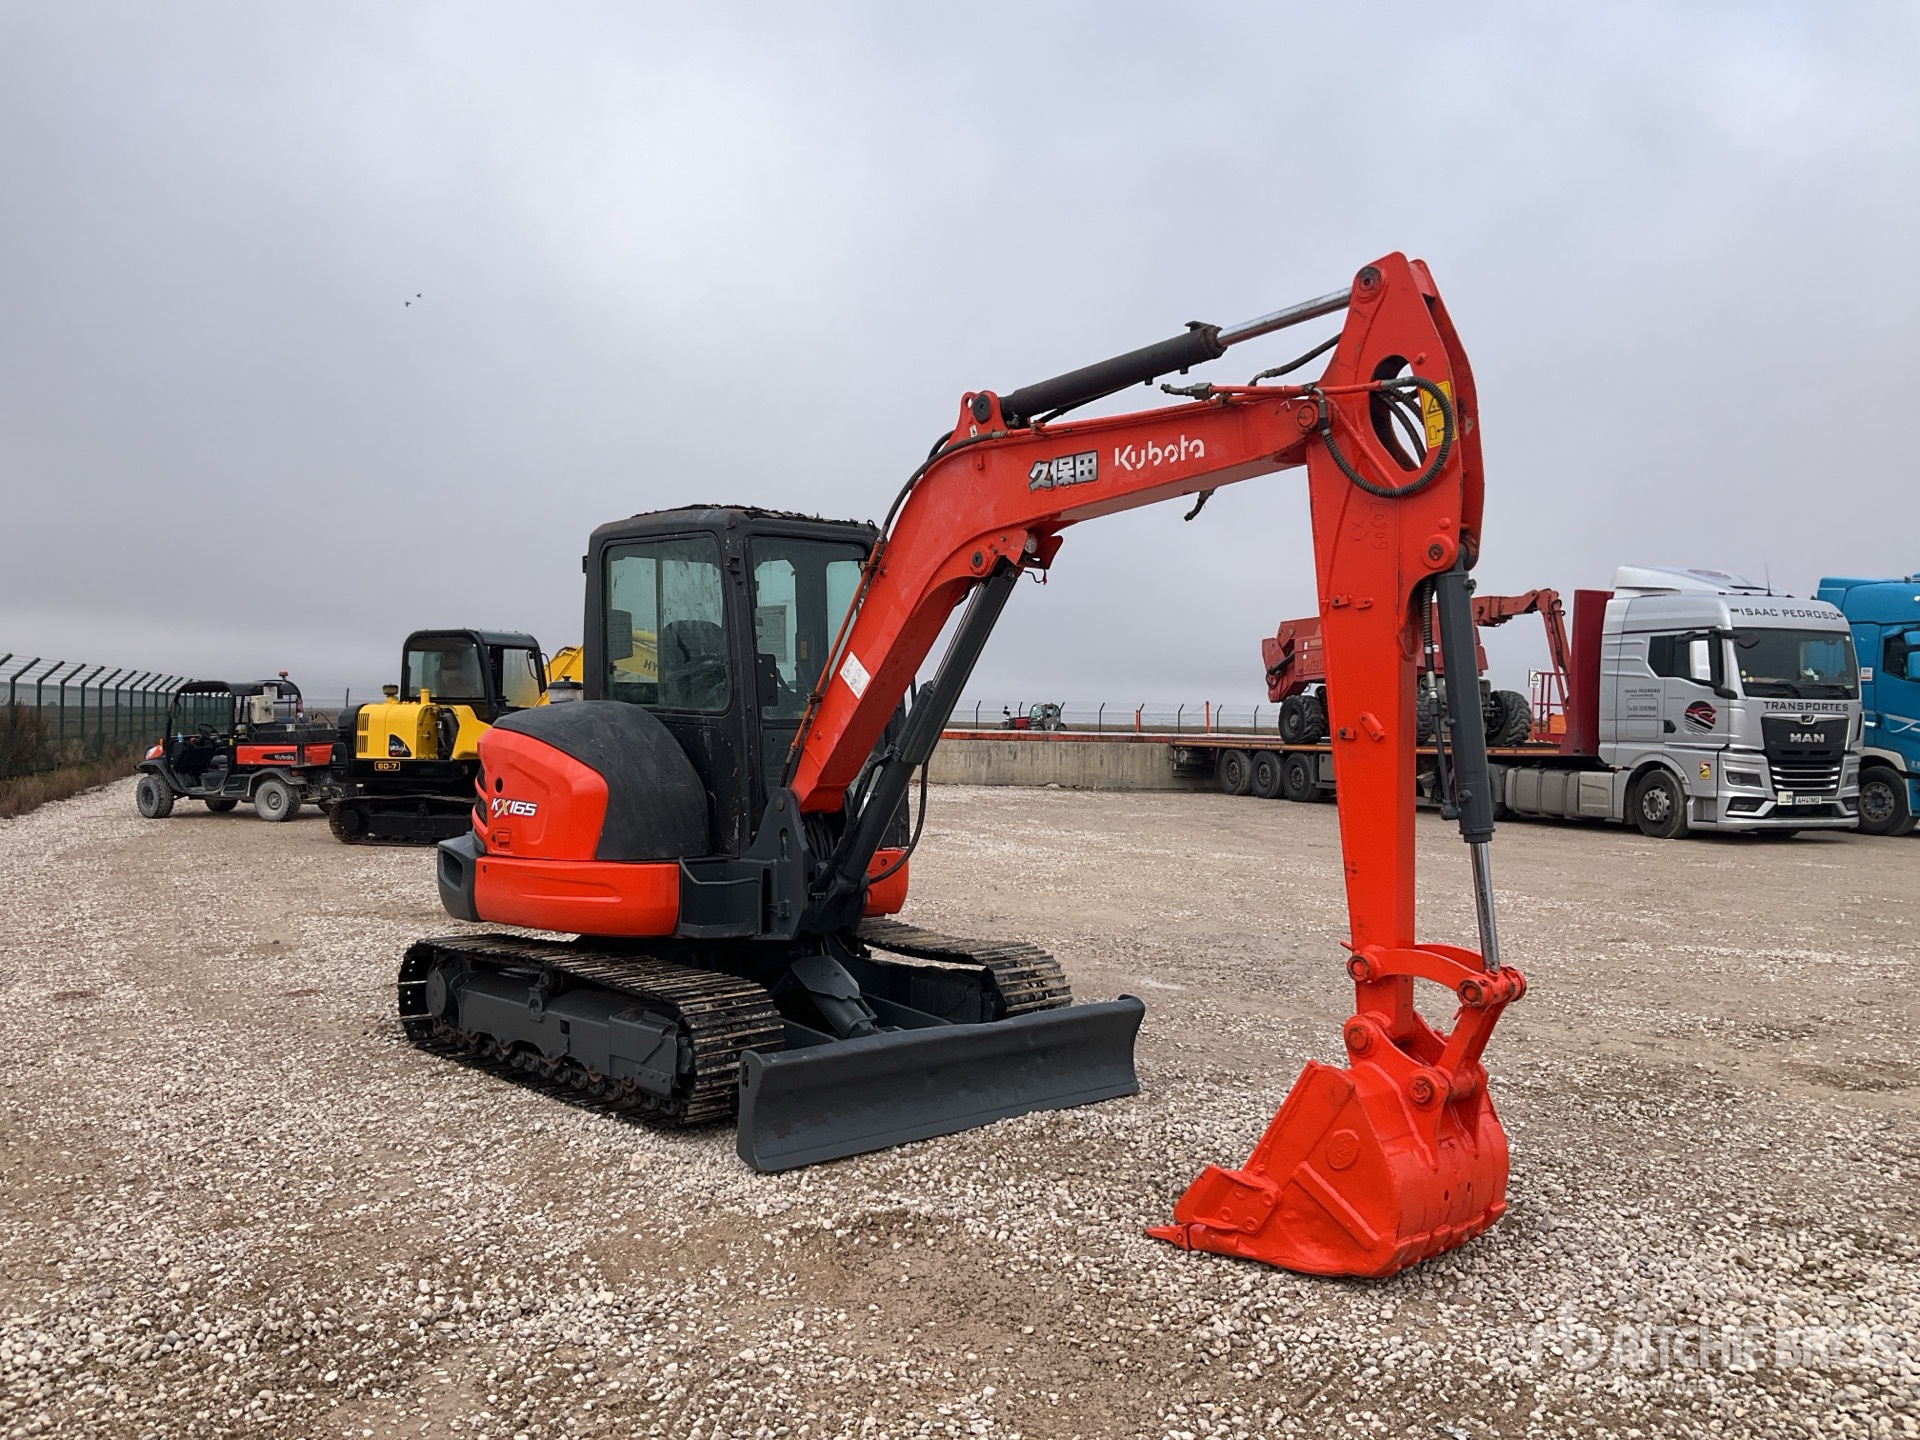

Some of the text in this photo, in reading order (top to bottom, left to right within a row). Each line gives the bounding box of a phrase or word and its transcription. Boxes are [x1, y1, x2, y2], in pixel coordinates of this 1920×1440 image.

[1114, 434, 1205, 471] Kubota
[1029, 451, 1098, 491] 久保田
[1740, 608, 1837, 620] ISAAC PEDROSO
[1763, 701, 1849, 712] TRANSPORTES
[1790, 733, 1825, 743] MAN
[491, 797, 538, 818] KX165
